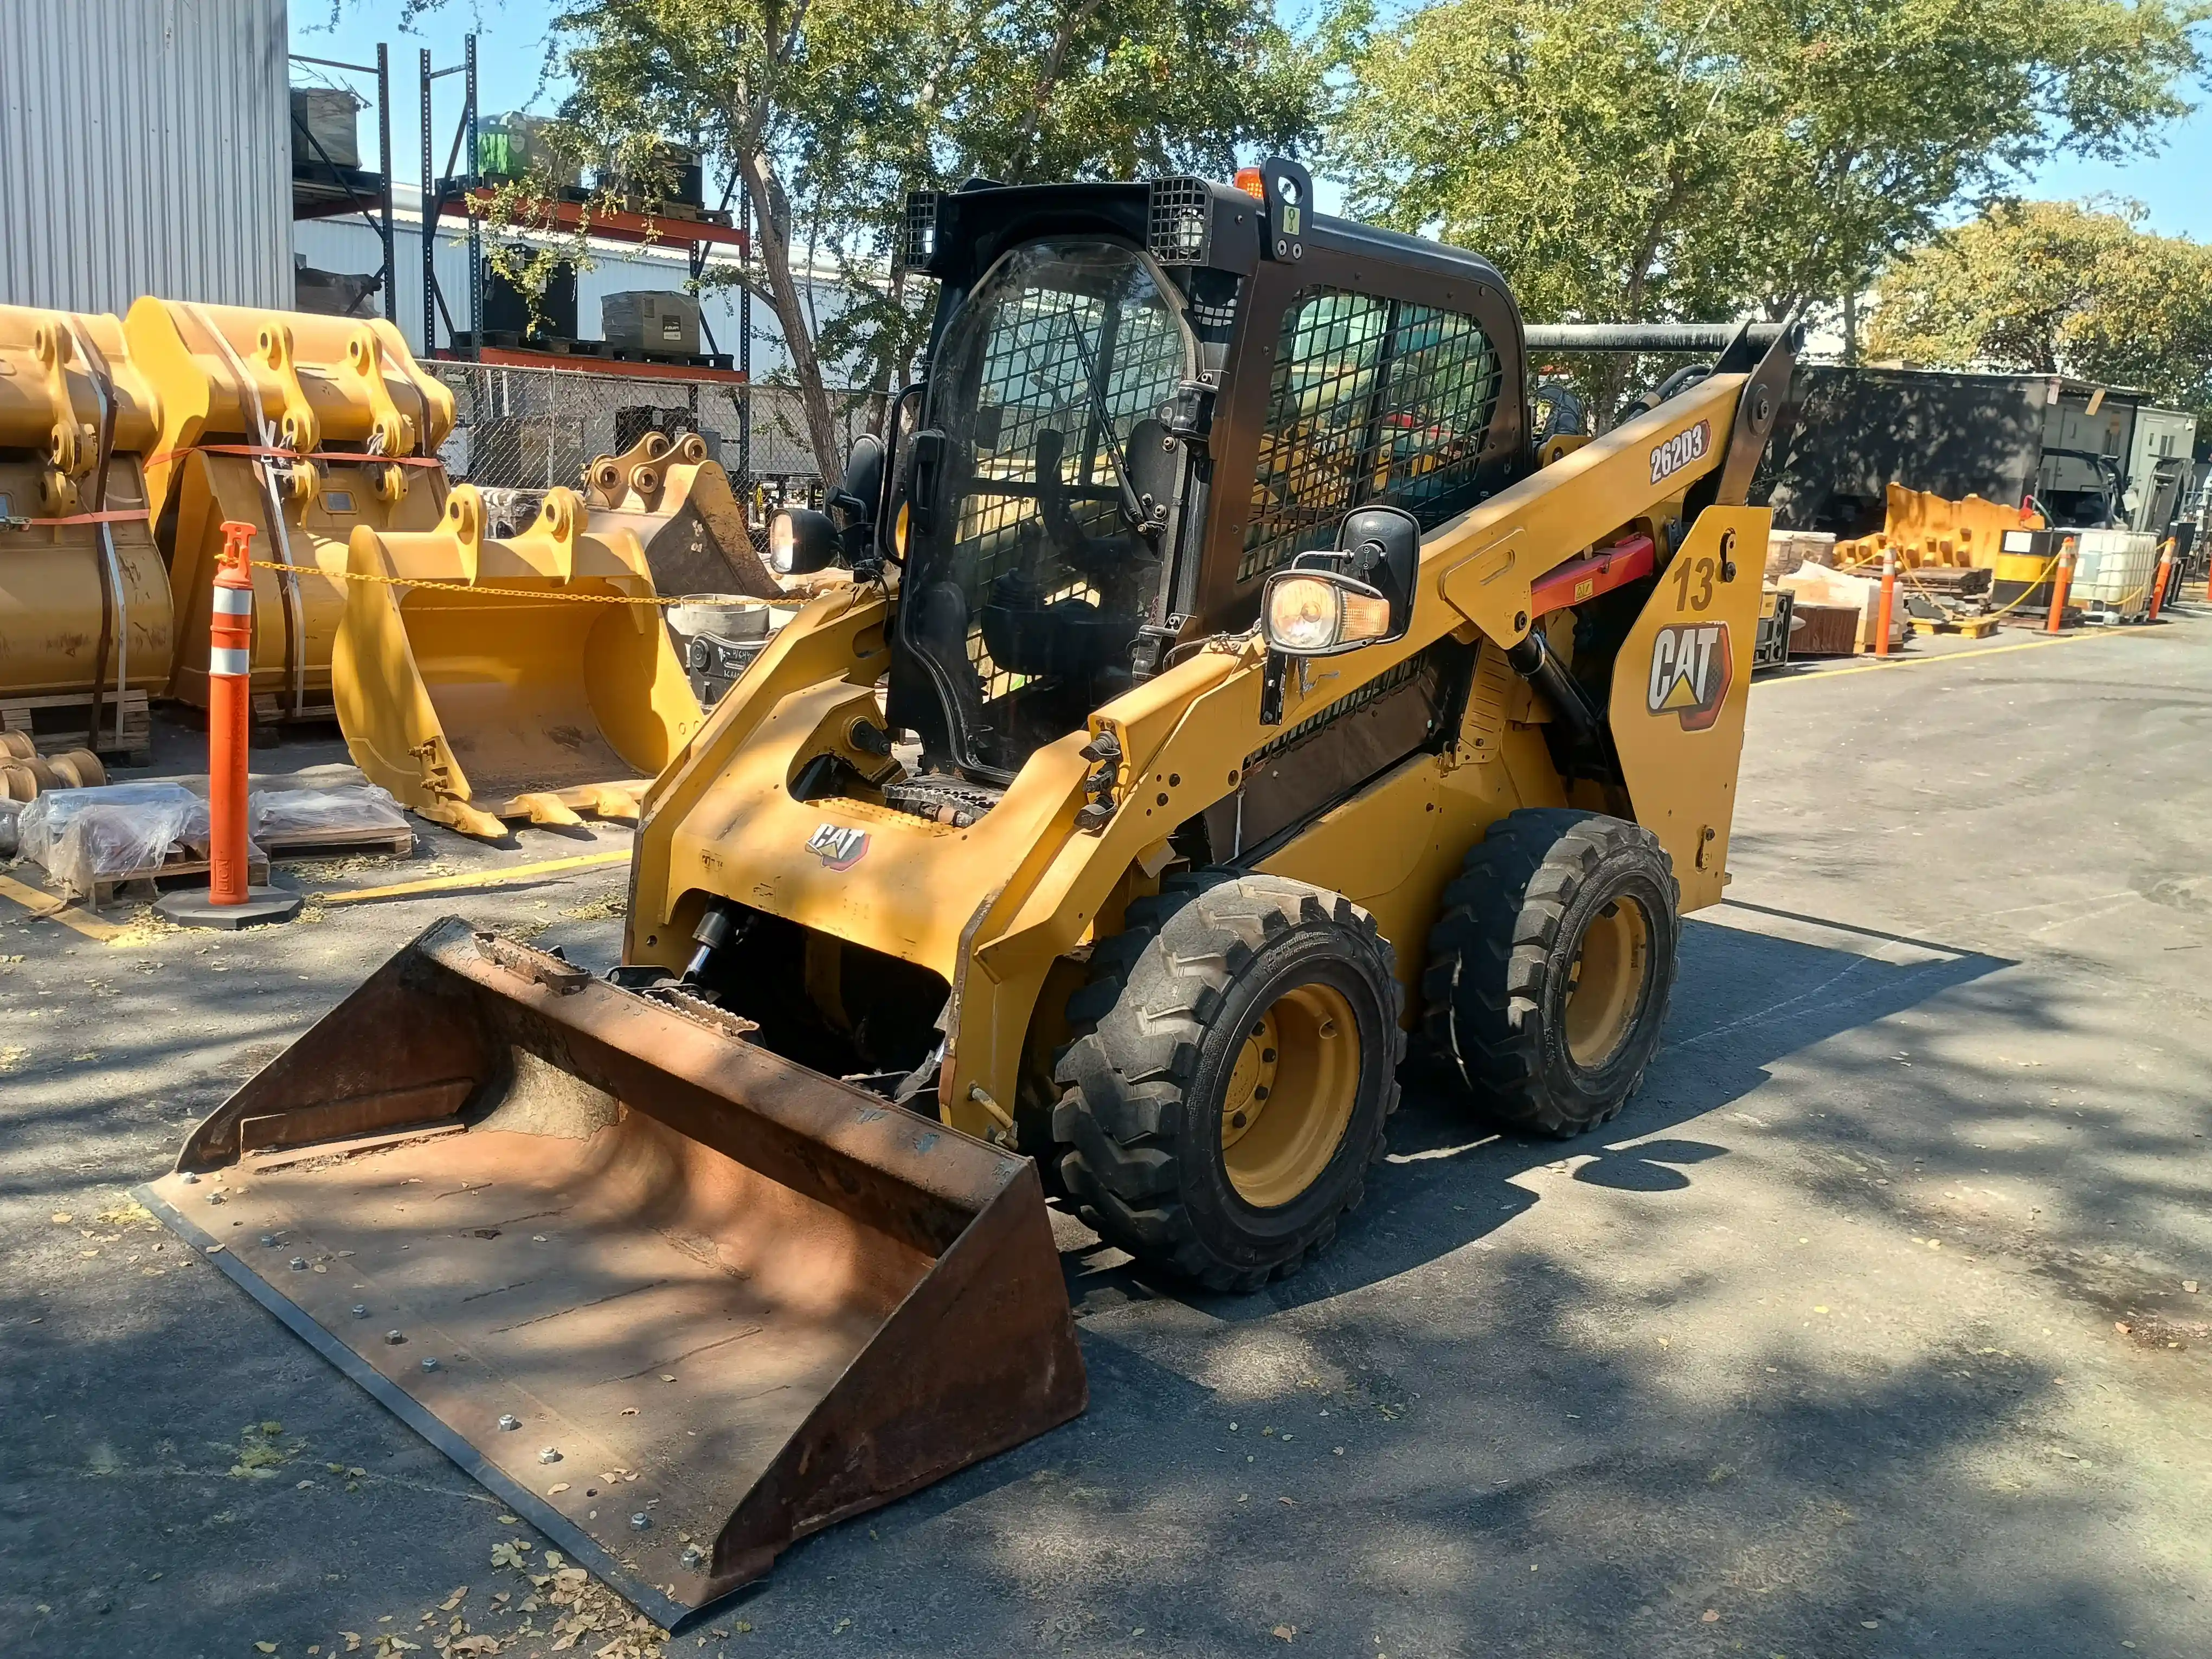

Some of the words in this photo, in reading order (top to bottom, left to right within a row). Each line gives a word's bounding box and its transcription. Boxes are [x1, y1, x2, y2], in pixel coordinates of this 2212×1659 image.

[1651, 425, 1702, 483] 262D3
[1673, 557, 1714, 612] 13
[1649, 627, 1719, 710] CAT
[812, 823, 865, 859] CAT
